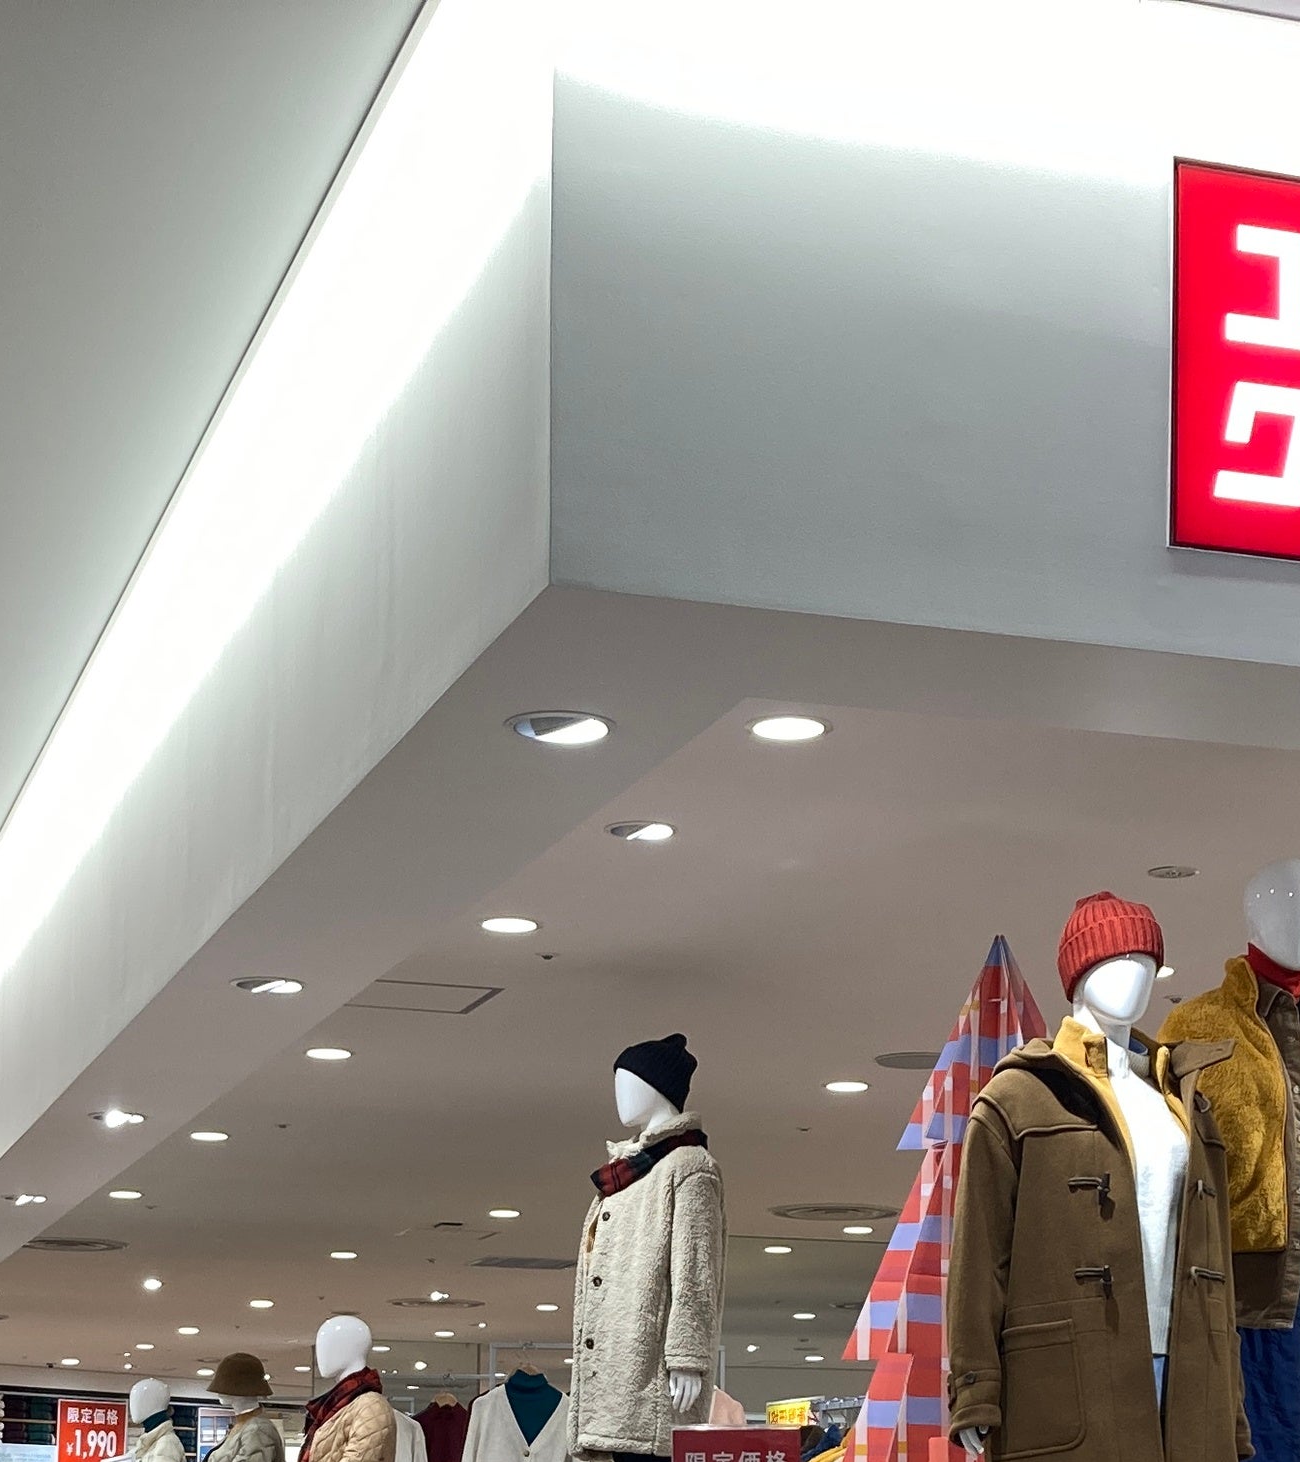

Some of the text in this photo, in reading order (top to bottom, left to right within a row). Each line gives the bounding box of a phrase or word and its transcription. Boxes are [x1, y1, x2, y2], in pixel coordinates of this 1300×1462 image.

[66, 1407, 119, 1425] 限定価格
[66, 1429, 117, 1457] ¥1,990
